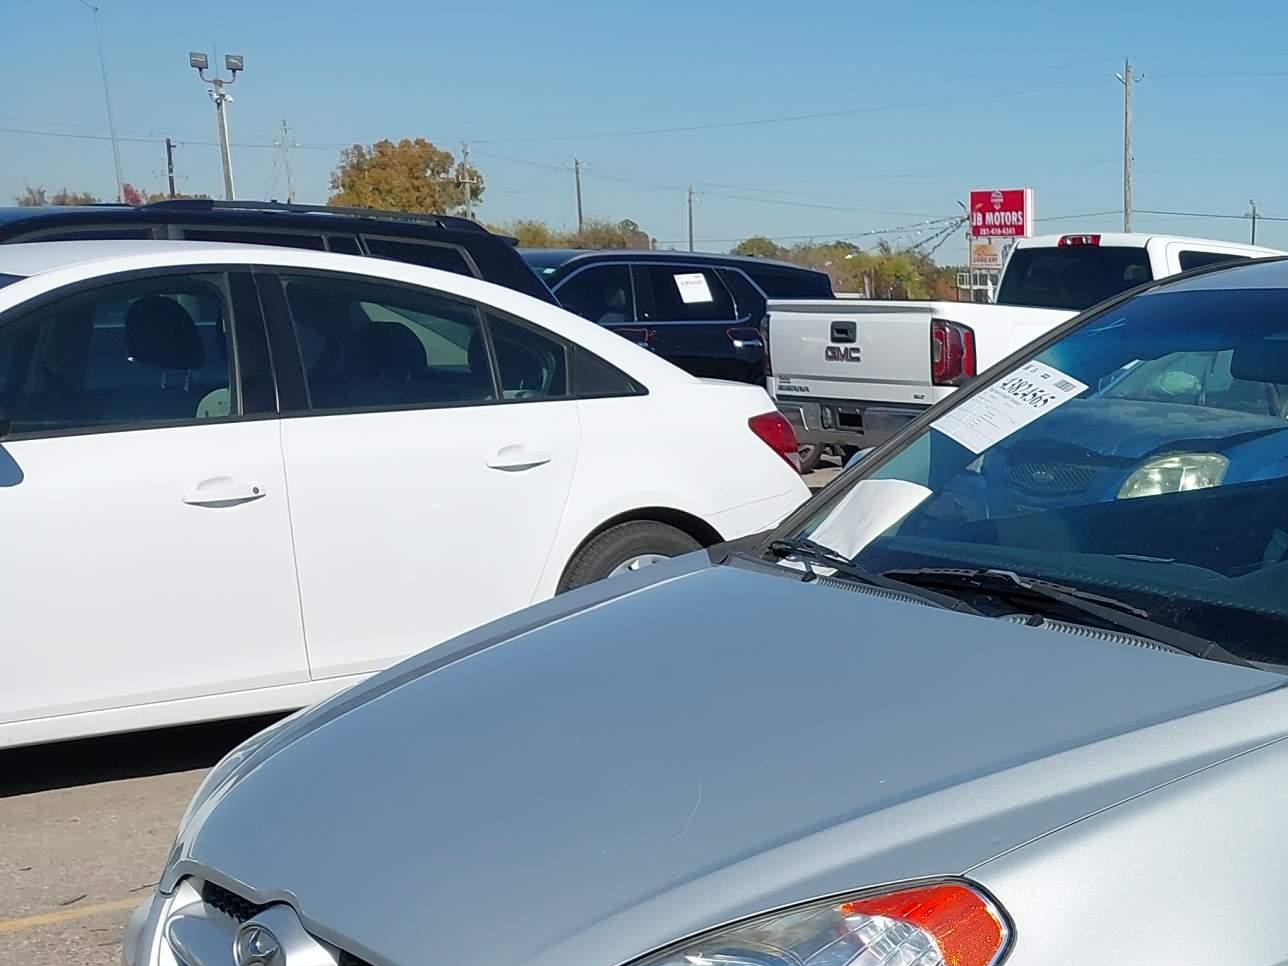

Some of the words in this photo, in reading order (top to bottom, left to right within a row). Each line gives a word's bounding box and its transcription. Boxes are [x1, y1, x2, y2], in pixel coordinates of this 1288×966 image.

[972, 212, 983, 226] JB
[985, 211, 1023, 226] MOTORS
[825, 346, 861, 362] GMC
[999, 376, 1057, 408] 43824565
